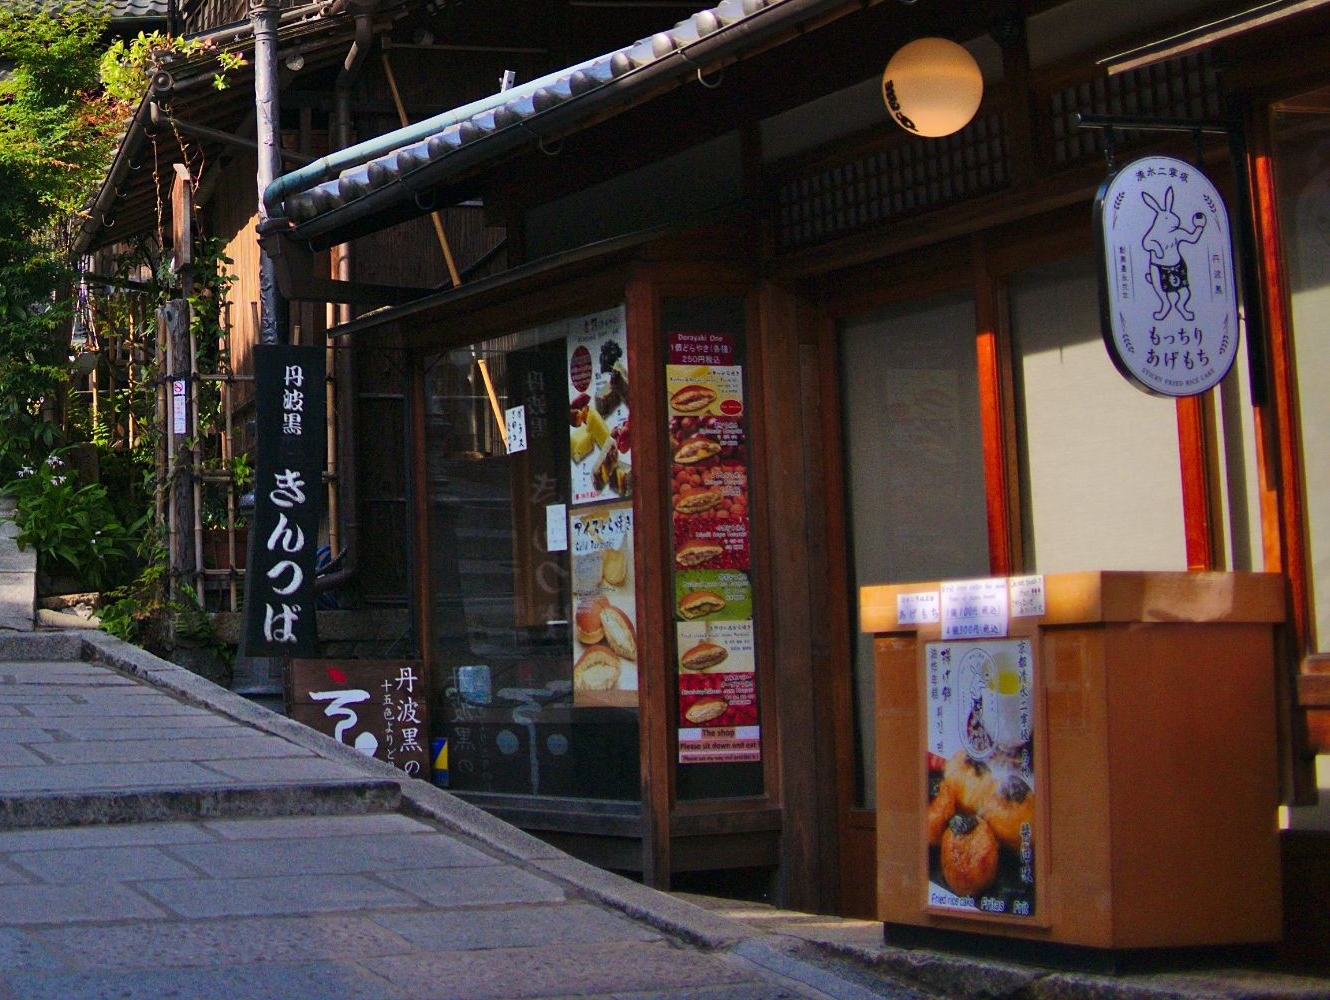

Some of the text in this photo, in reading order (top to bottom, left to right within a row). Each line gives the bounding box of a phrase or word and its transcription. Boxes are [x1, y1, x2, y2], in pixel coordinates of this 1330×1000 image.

[677, 333, 707, 342] Dorayaki
[1149, 327, 1203, 347] もっちり
[1147, 350, 1210, 370] あげもち
[263, 365, 306, 643] 丹波黒 きんつば
[381, 680, 396, 767] 十五色よりど
[395, 667, 423, 775] 丹波黒の
[931, 892, 946, 904] Fried
